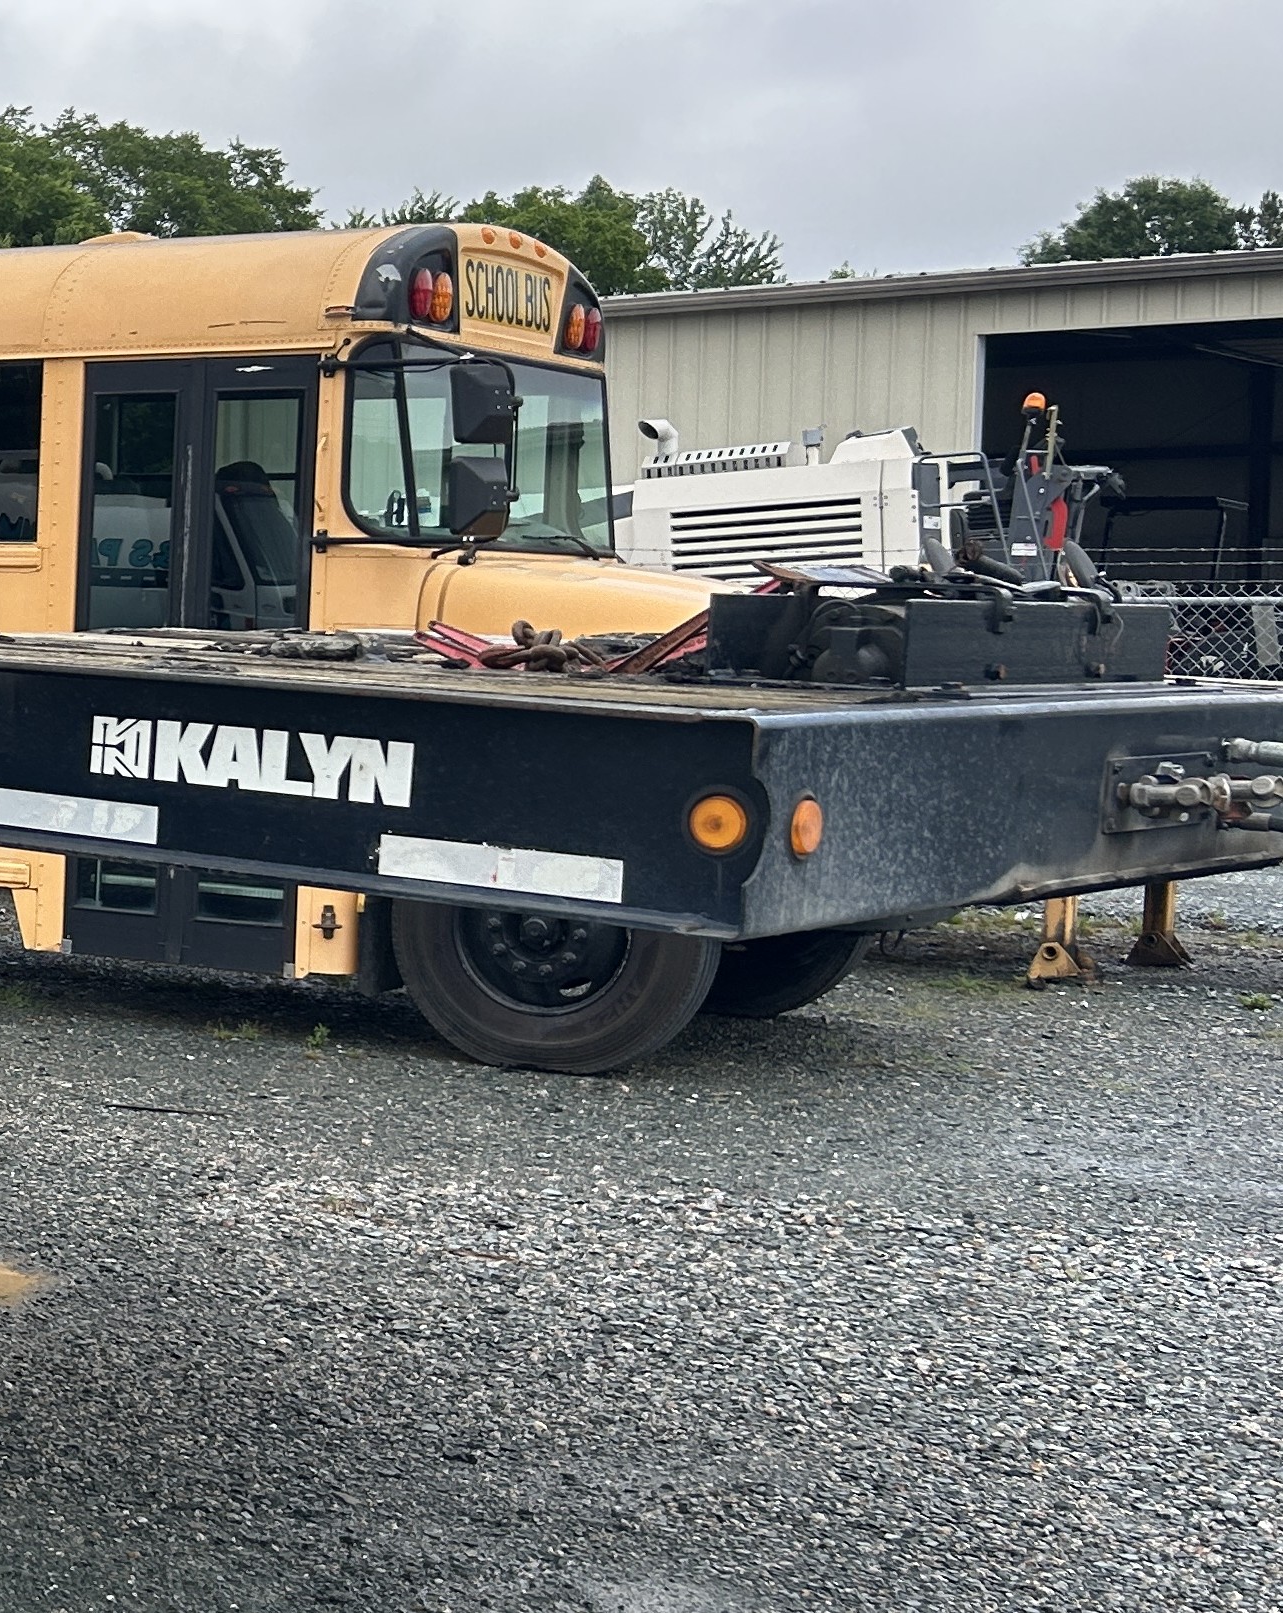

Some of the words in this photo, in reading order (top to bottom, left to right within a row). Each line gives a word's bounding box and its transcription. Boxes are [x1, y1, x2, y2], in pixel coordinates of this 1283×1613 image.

[465, 258, 523, 327] SCHOOL
[525, 272, 551, 332] BUS
[153, 719, 415, 808] KALYN
